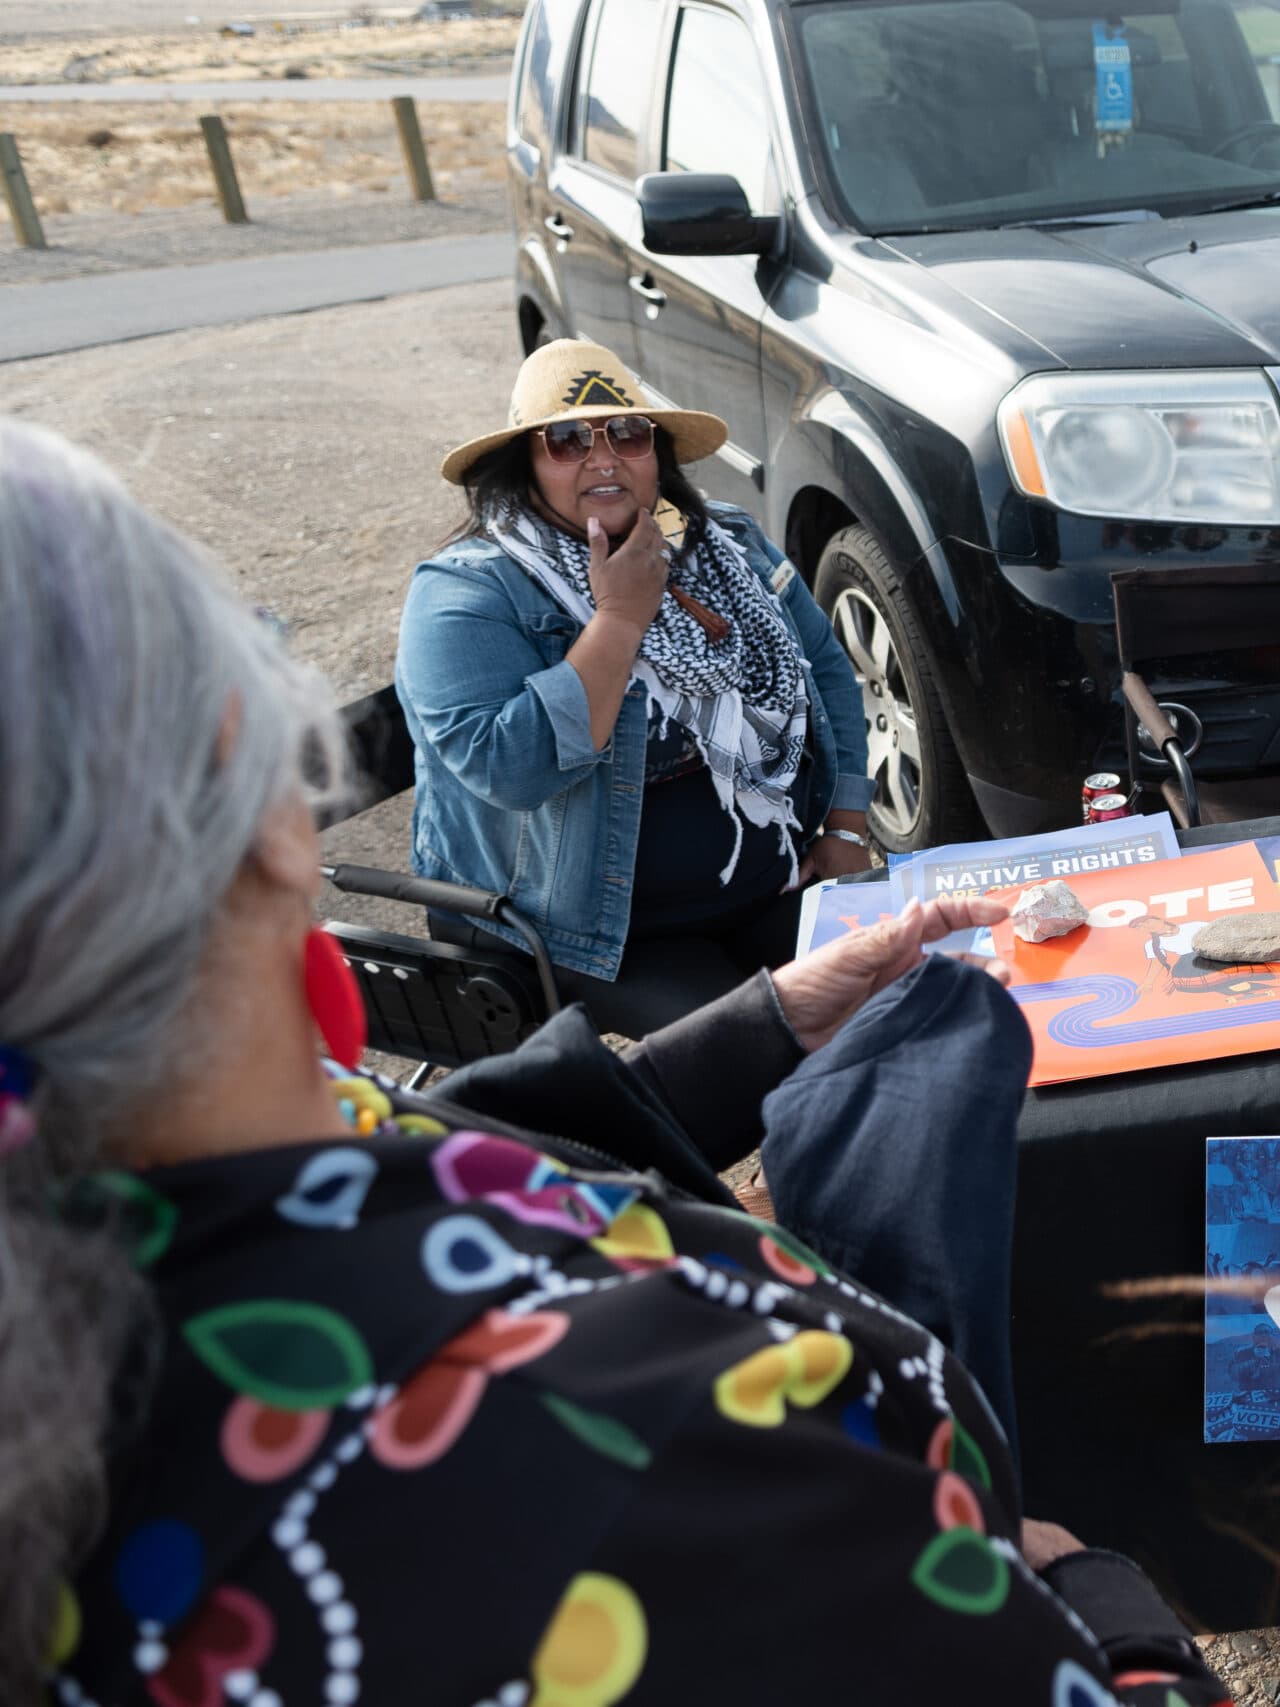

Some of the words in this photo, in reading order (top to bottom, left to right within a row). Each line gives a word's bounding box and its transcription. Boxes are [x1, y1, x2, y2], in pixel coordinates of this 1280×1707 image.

[936, 864, 1041, 891] NATIVE
[1053, 845, 1156, 875] RIGHTS
[1086, 877, 1256, 928] OTE
[1237, 1411, 1280, 1427] VOTE
